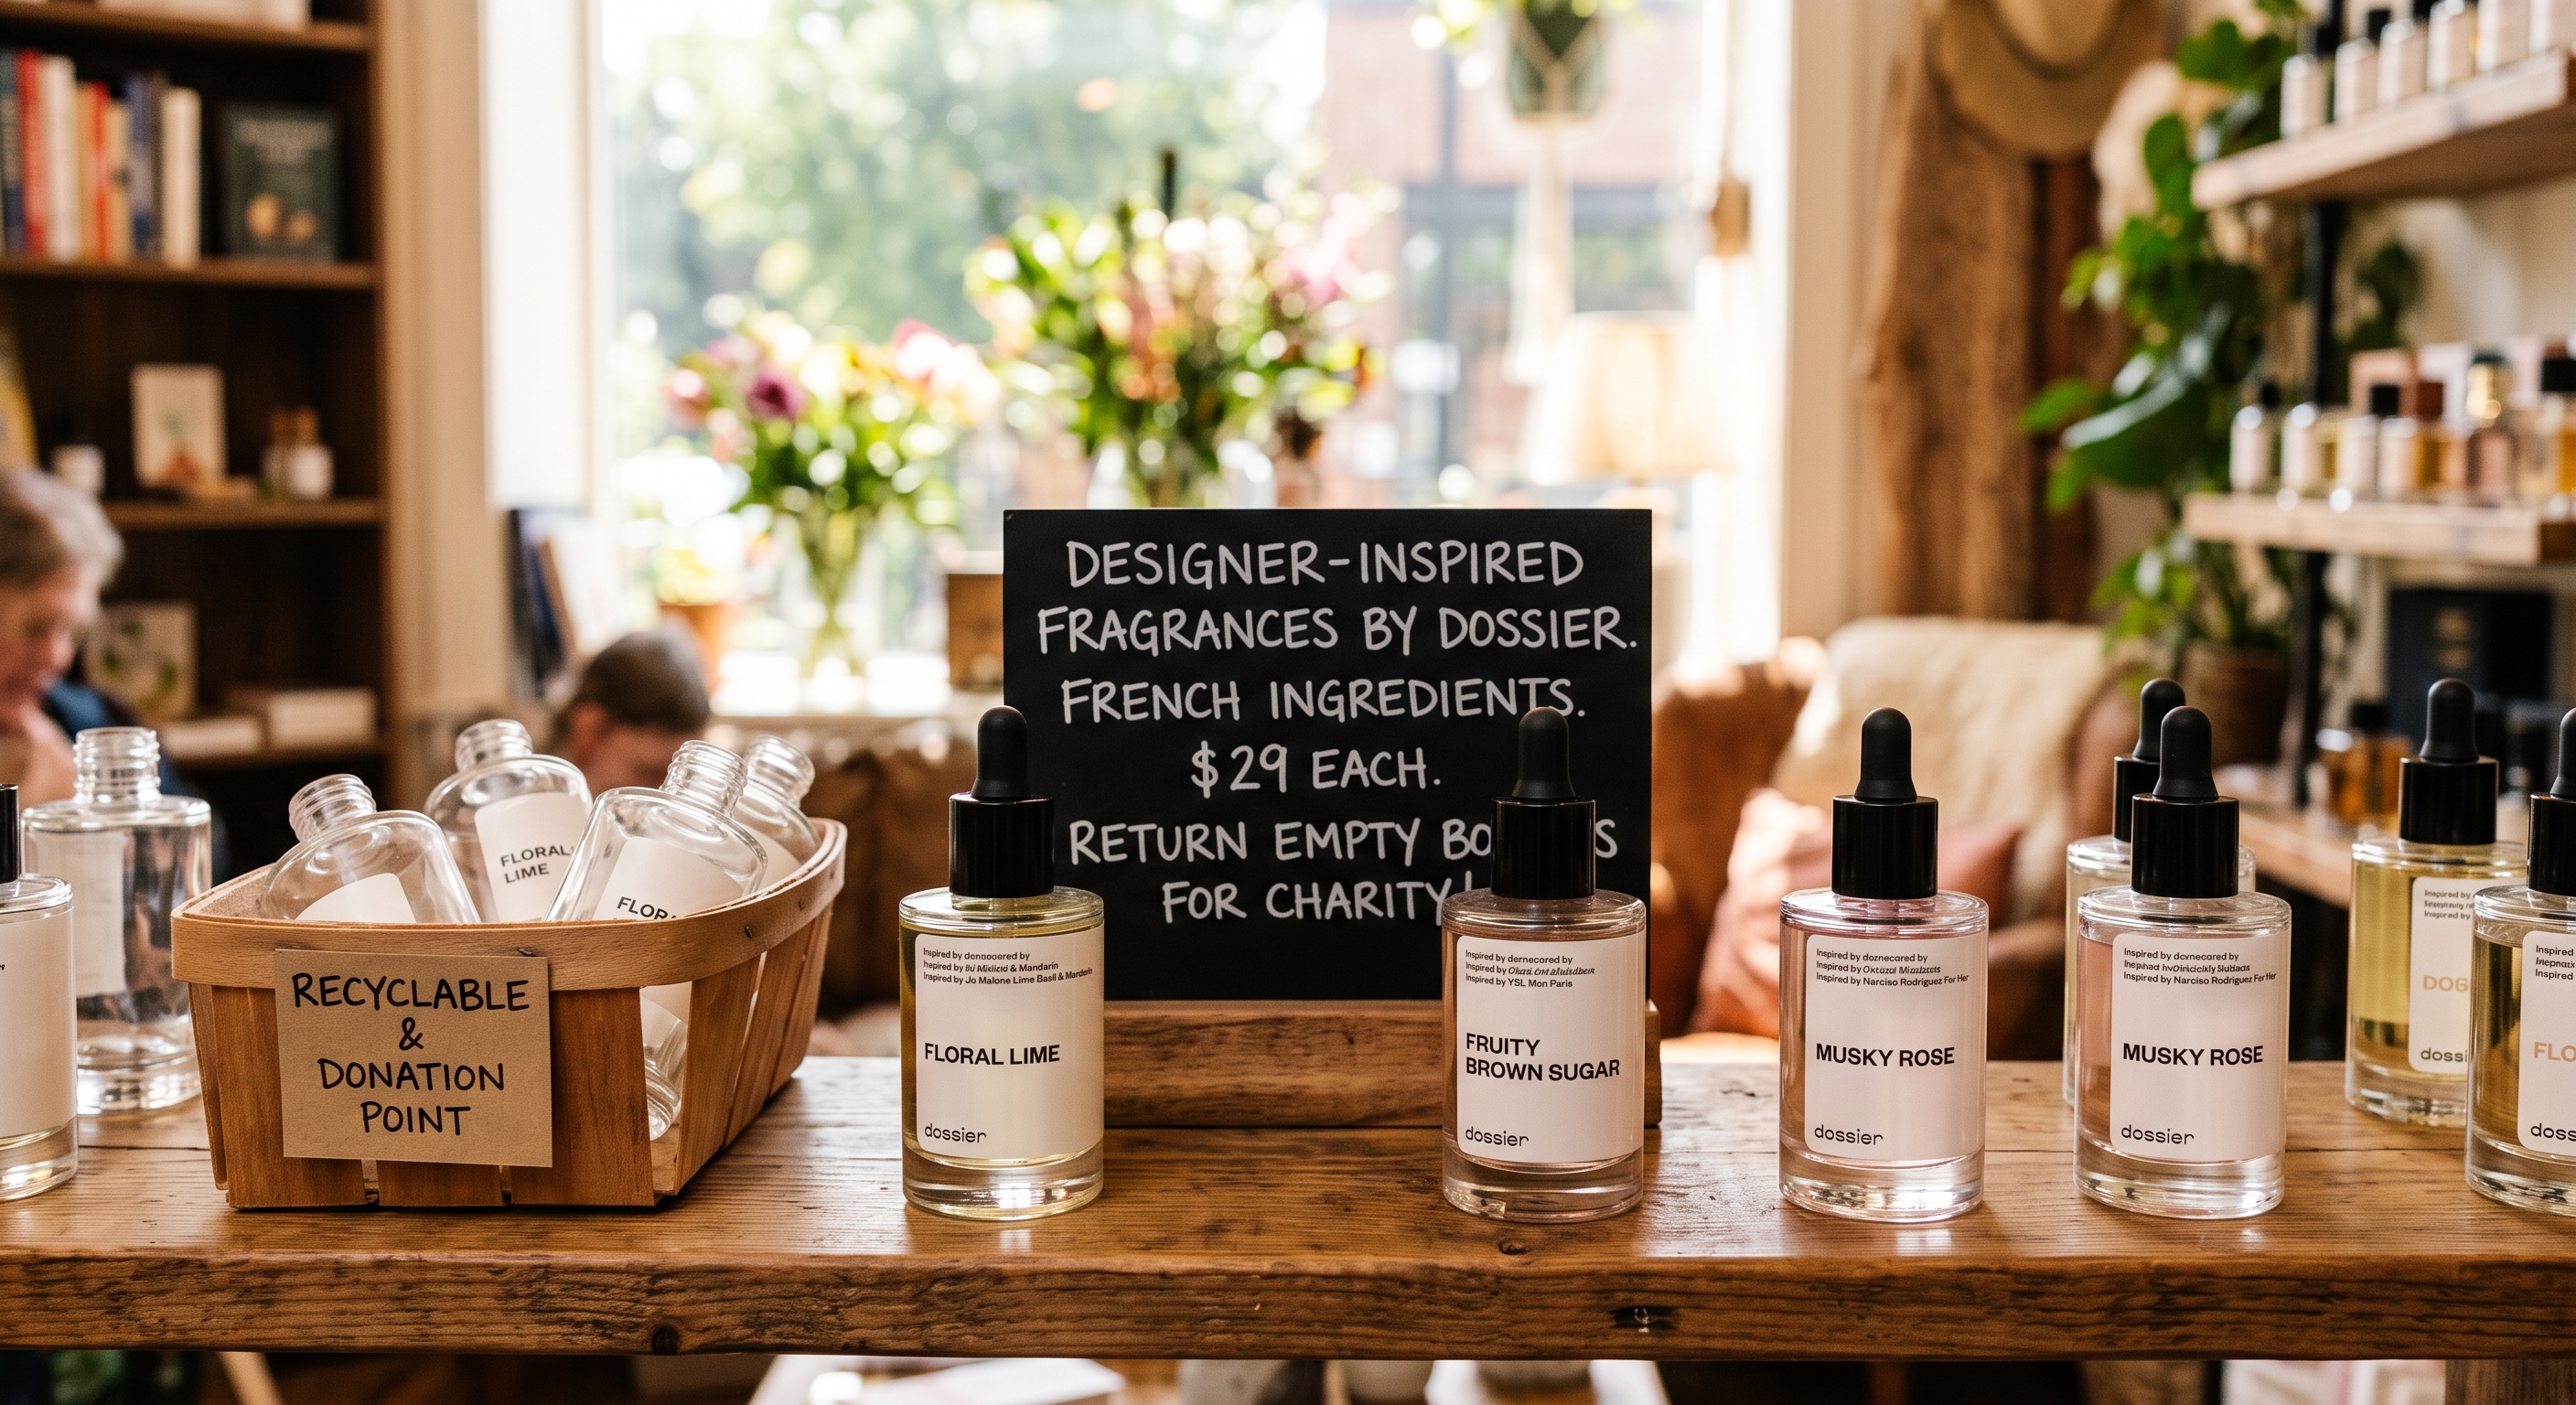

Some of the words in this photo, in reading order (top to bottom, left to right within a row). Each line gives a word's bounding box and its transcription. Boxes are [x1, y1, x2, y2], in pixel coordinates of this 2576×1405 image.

[1066, 541, 1584, 588] DESIGNER-INSPIRED
[1037, 605, 1339, 656] FRAGRANCES
[1362, 605, 1418, 656] BY
[1438, 606, 1638, 650] DOSSIER.
[1061, 678, 1241, 724] FRENCH
[1269, 678, 1586, 723] INGREDIENTS.
[1190, 740, 1288, 799] $29
[1311, 746, 1442, 791] EACH.
[1069, 820, 1249, 866] RETURN
[1274, 817, 1421, 867] EMPTY
[500, 844, 570, 868] FLORAL
[504, 863, 550, 885] LIME
[617, 896, 677, 920] FLOR
[1162, 881, 1248, 924] FOR
[923, 947, 951, 959] Inspired
[952, 950, 962, 960] by
[1019, 951, 1030, 960] by
[1465, 949, 1494, 960] Inspired
[1496, 953, 1506, 963] by
[1562, 956, 1572, 965] by
[1816, 949, 1848, 960] Inspired
[1850, 952, 1861, 962] by
[1917, 953, 1928, 963] by
[2123, 948, 2158, 959] Inspired
[2160, 951, 2172, 961] by
[2228, 952, 2239, 961] by
[2536, 945, 2574, 957] Inspired
[953, 962, 963, 972] by
[1010, 964, 1017, 972] &
[1019, 961, 1058, 972] Mandarin
[1465, 961, 1495, 973] Inspired
[1496, 965, 1507, 975] by
[1816, 960, 1849, 972] Inspired
[1851, 965, 1862, 974] by
[2535, 969, 2573, 981] Inspired
[953, 975, 963, 985] by
[965, 976, 977, 984] Jo
[1013, 976, 1035, 984] Lime
[1057, 972, 1065, 981] &
[1465, 973, 1495, 985] Inspired
[1496, 978, 1507, 987] by
[1508, 978, 1526, 987] YSL
[1550, 980, 1572, 988] Paris
[1816, 972, 1849, 983] Inspired
[1851, 977, 1862, 986] by
[1862, 977, 1898, 986] Narciso
[1900, 977, 1942, 987] Rodriguez
[1957, 973, 1969, 982] Her
[2123, 971, 2158, 982] Inspired
[2160, 975, 2172, 984] by
[2174, 976, 2209, 984] Narciso
[2211, 976, 2252, 986] Rodriguez
[291, 972, 530, 1012] RECYCLABLE
[399, 1016, 424, 1051] &
[924, 1043, 1004, 1065] FLORAL
[1010, 1044, 1060, 1065] LIME
[1466, 1033, 1540, 1056] FRUITY
[1816, 1043, 1894, 1067] MUSKY
[1899, 1046, 1955, 1067] ROSE
[2123, 1043, 2205, 1066] MUSKY
[2210, 1046, 2263, 1066] ROSE
[2420, 1047, 2468, 1063] dossi
[2533, 1041, 2576, 1063] FLO
[317, 1057, 505, 1091] DONATION
[1466, 1056, 1542, 1080] BROWN
[1548, 1059, 1620, 1081] SUGAR
[360, 1100, 471, 1136] POINT
[924, 1123, 987, 1142] dossier
[1465, 1126, 1529, 1146] dossier
[1814, 1124, 1884, 1144] dossier
[2121, 1124, 2194, 1144] dossier
[2530, 1122, 2576, 1142] doss
